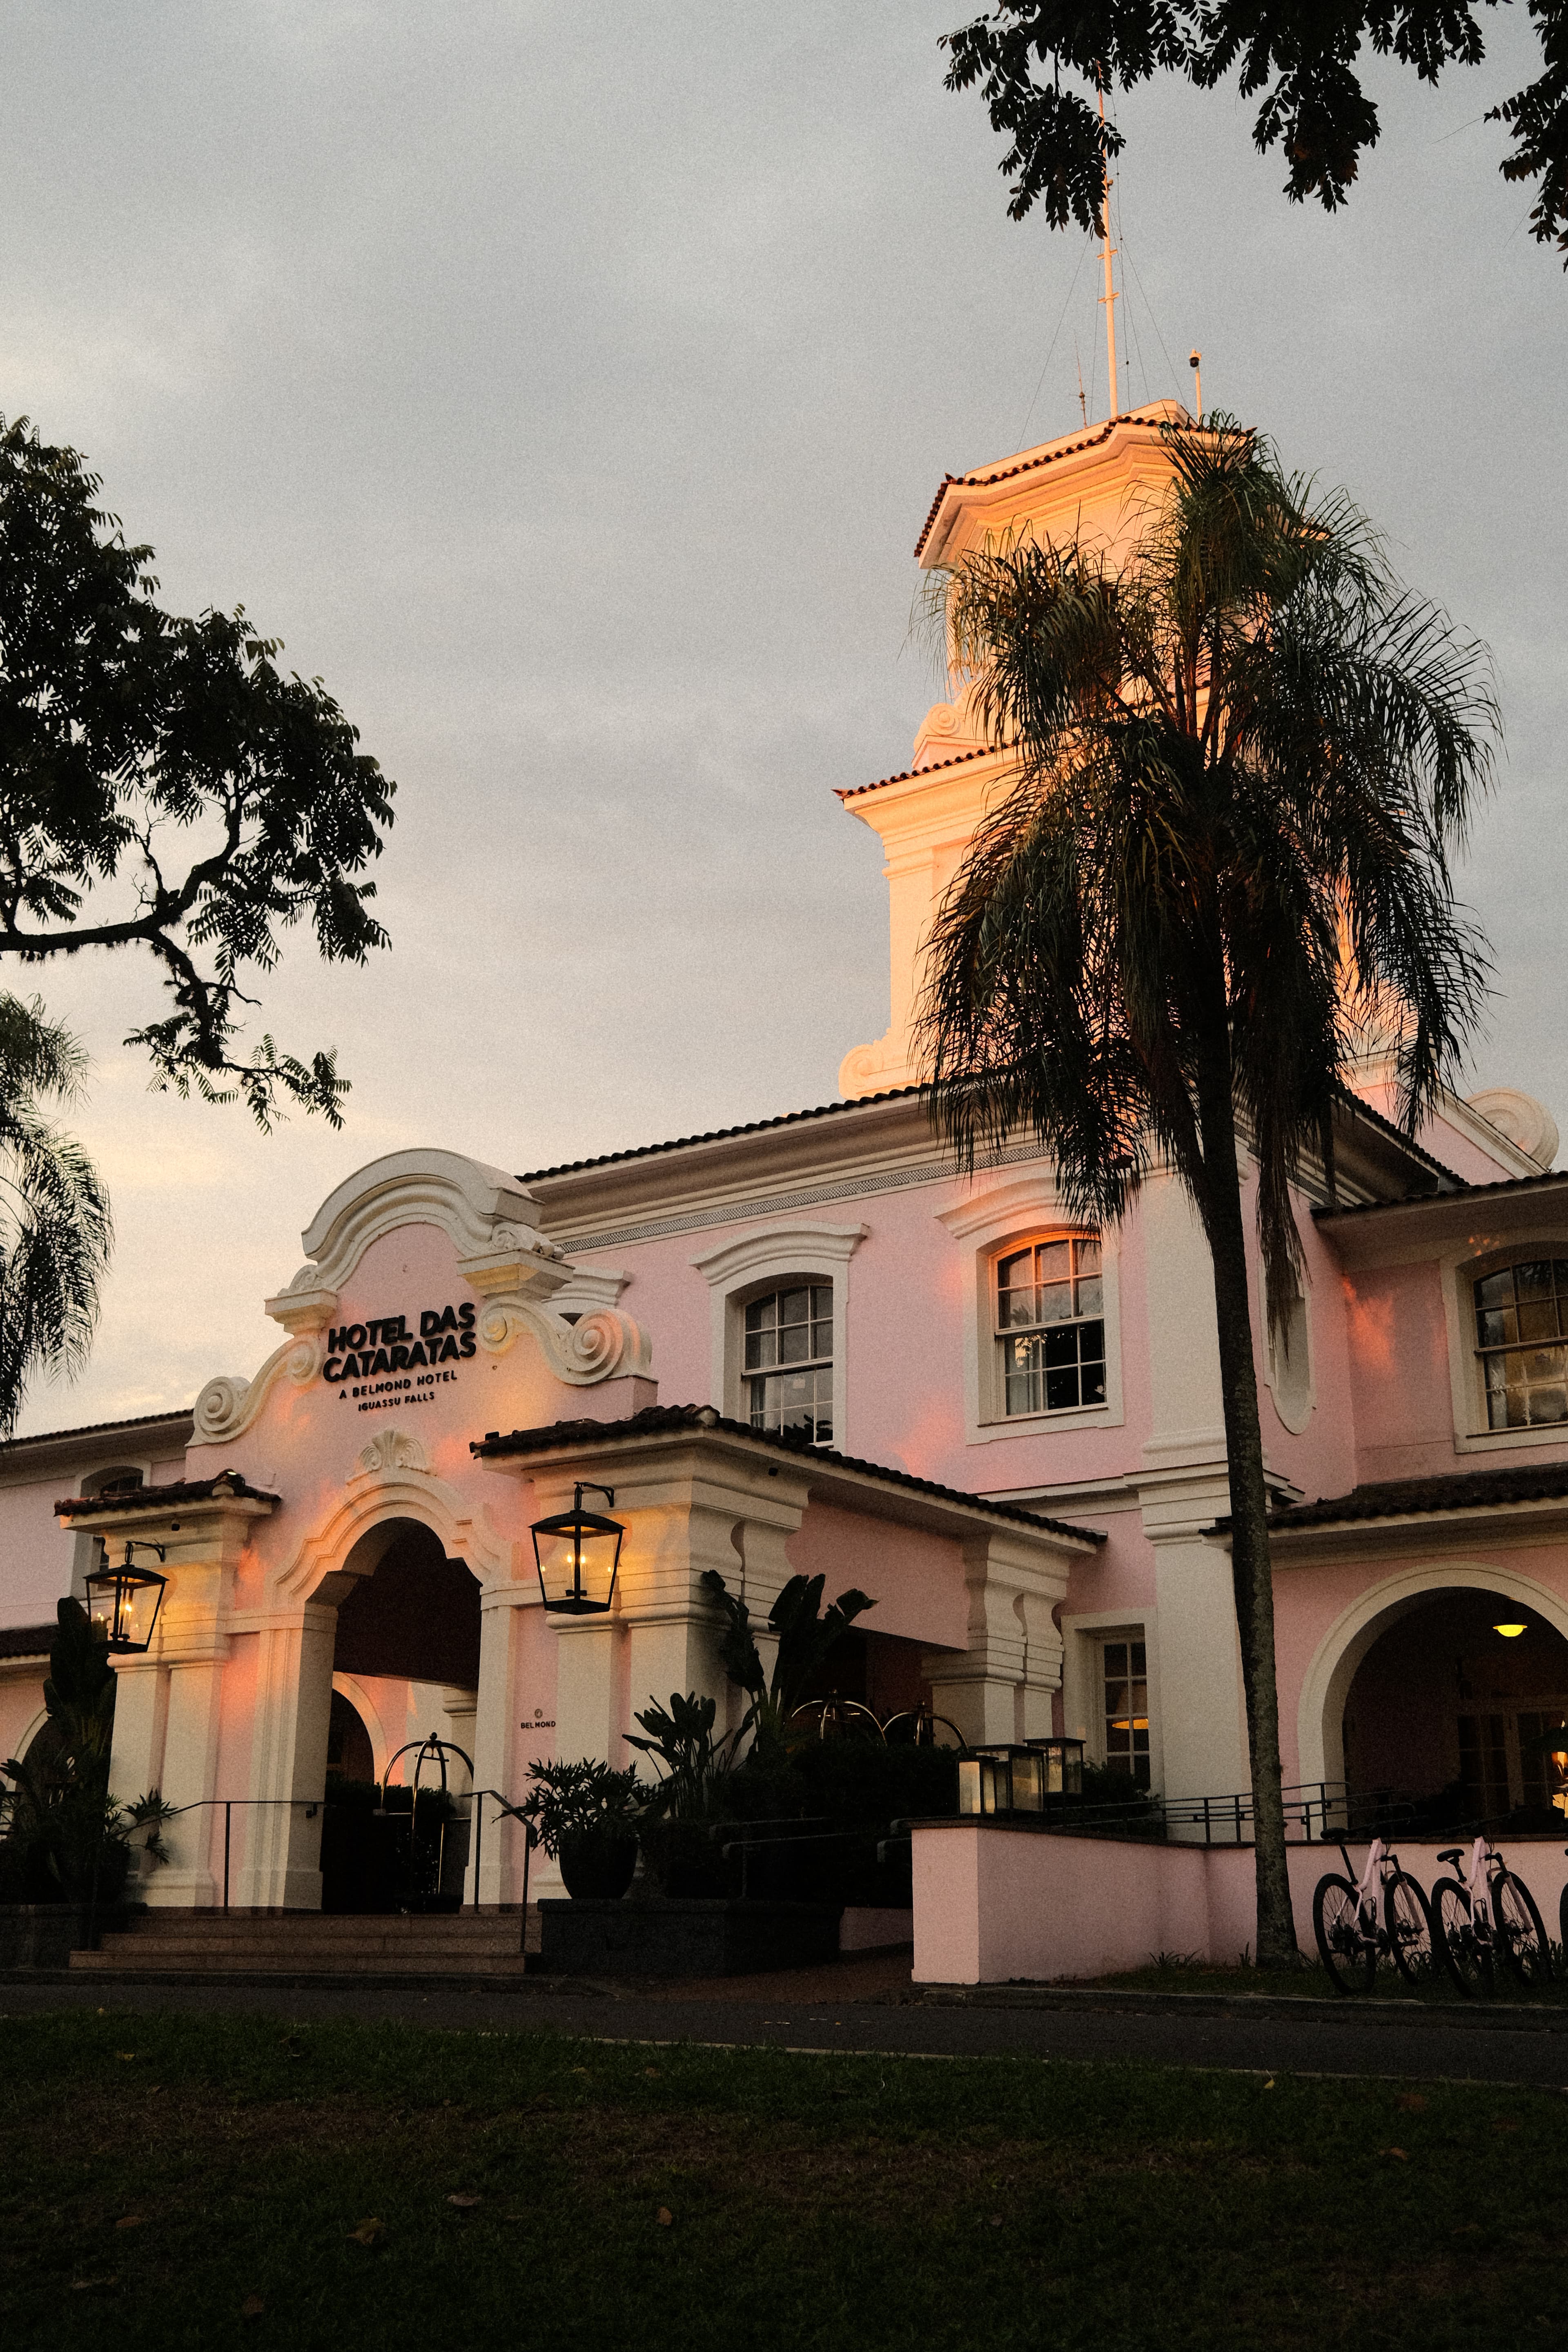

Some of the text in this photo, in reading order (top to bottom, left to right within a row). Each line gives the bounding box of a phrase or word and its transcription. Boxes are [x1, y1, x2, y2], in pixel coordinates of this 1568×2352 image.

[328, 1303, 475, 1353] HOTEL DAS
[323, 1332, 476, 1383] CATARATAS
[339, 1370, 457, 1399] A BELMOND HOTEL
[358, 1392, 434, 1411] IGUASSU FALLS
